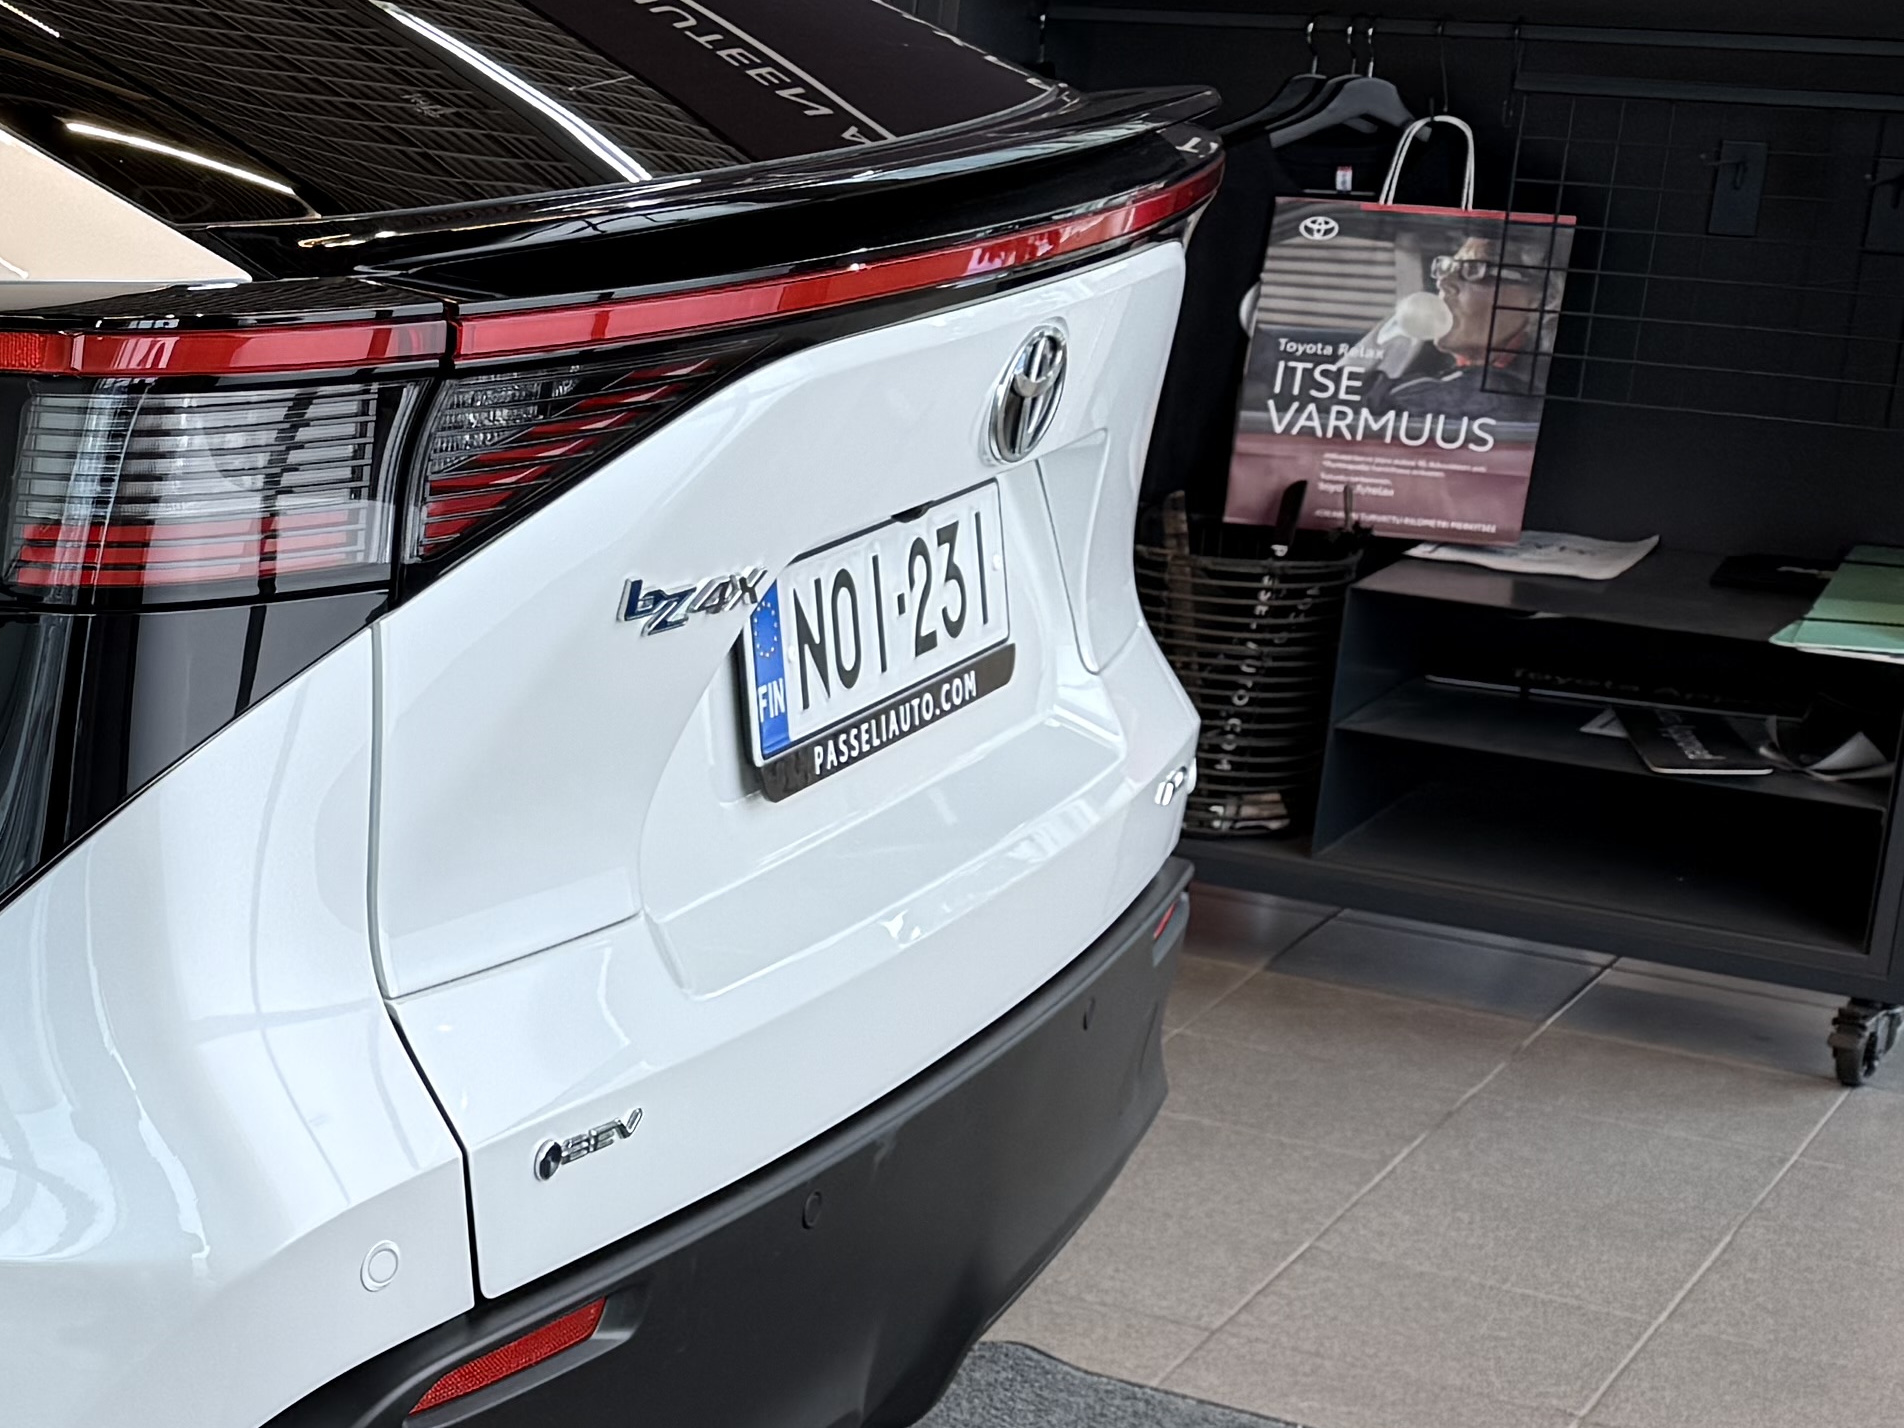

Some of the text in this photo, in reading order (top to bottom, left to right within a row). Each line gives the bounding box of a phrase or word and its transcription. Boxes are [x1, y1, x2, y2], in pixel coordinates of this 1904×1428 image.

[1278, 338, 1333, 356] Toyota
[1273, 360, 1366, 401] ITSE
[1267, 399, 1497, 453] VARMUUS
[793, 511, 989, 711] NOI-231
[757, 677, 786, 723] FIN
[813, 670, 978, 776] PASSELIAUTO.COM
